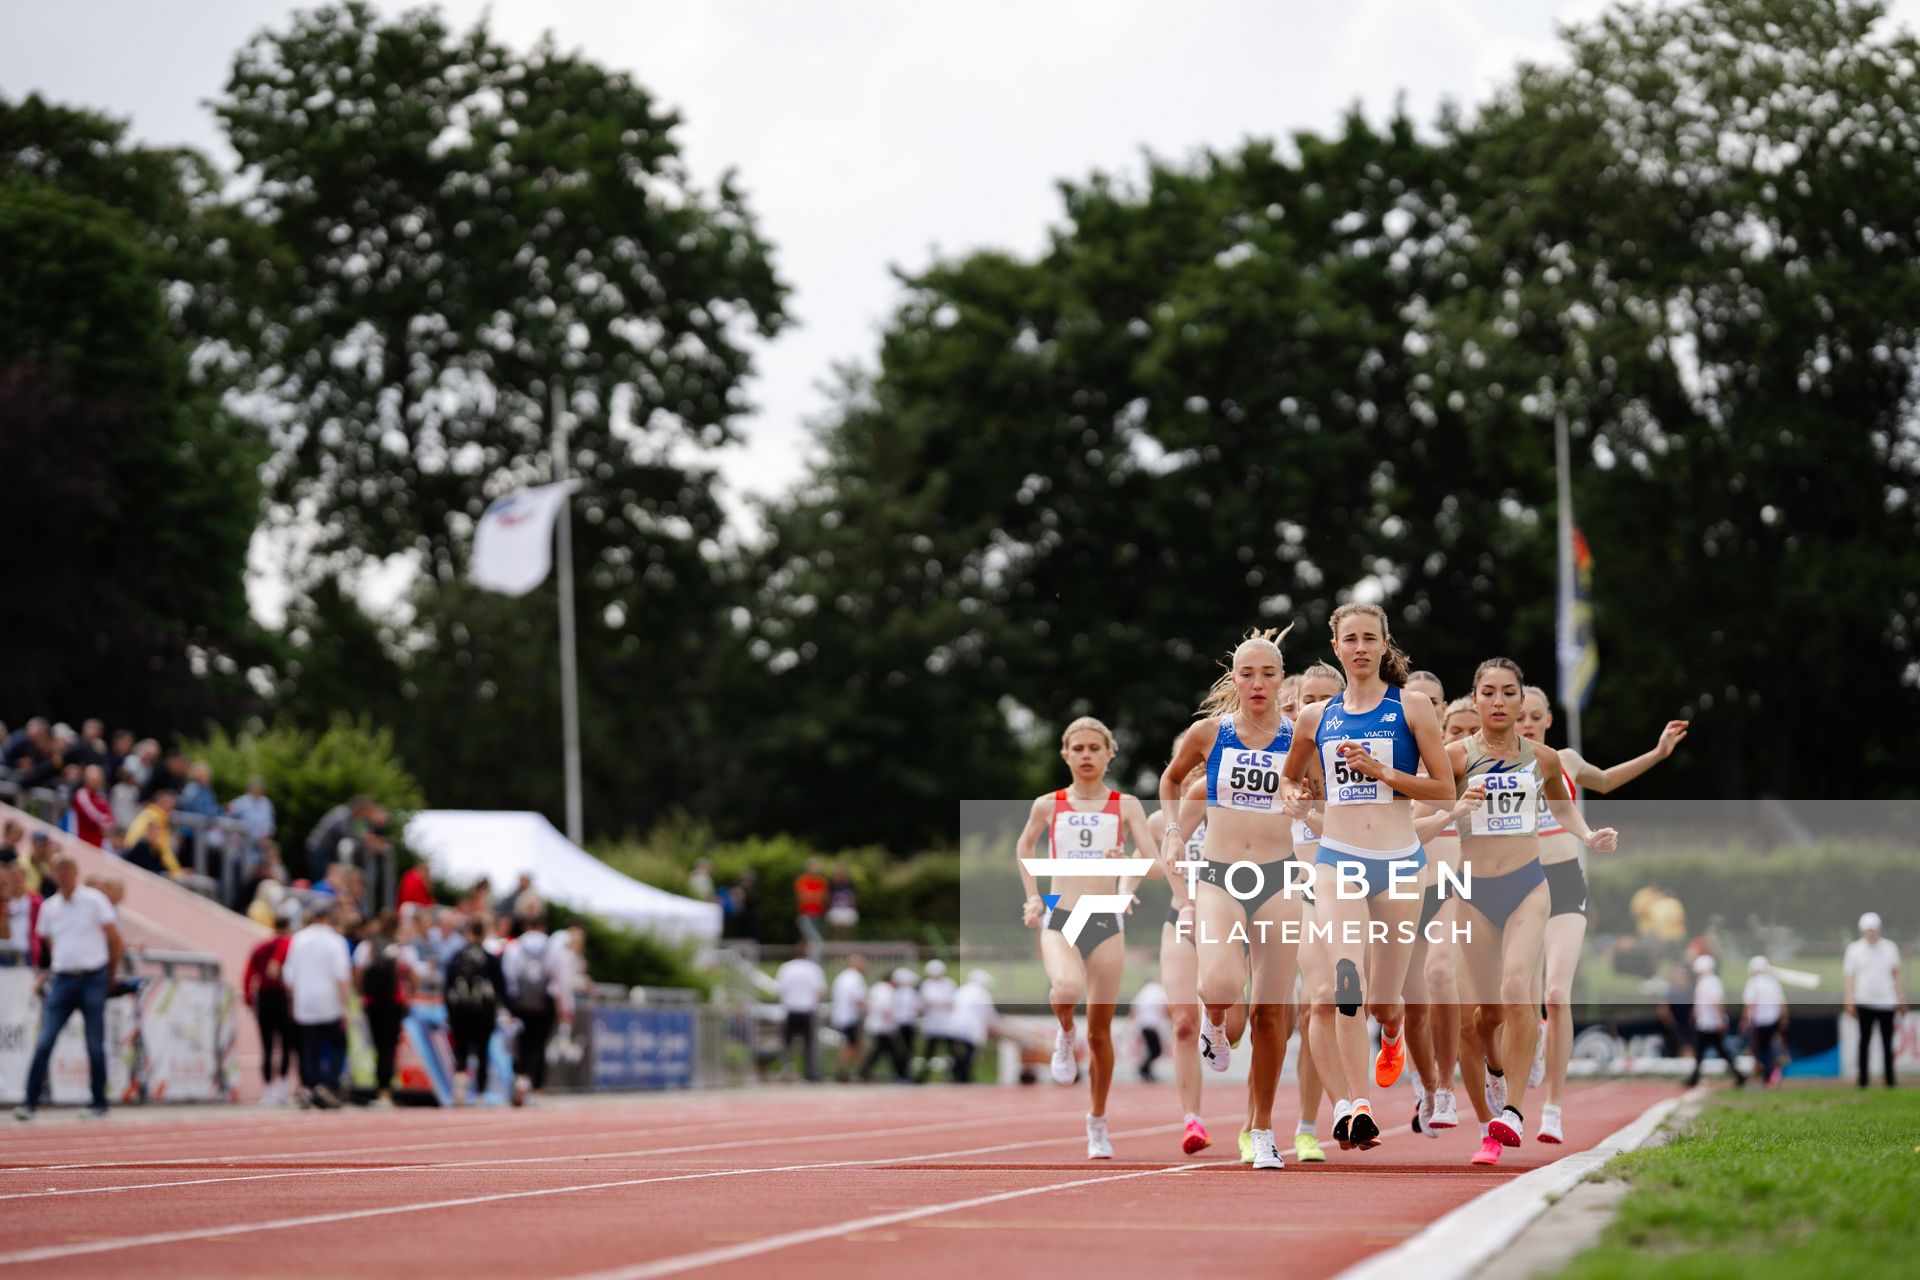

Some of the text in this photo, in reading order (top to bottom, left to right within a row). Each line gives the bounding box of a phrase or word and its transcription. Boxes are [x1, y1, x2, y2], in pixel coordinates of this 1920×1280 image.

[1363, 730, 1395, 738] VIACTIV
[1236, 752, 1273, 768] GLS
[1334, 759, 1380, 785] 58
[1230, 766, 1280, 794] 590
[1484, 776, 1518, 790] GLS
[1352, 787, 1375, 795] PLAN
[1248, 795, 1271, 805] PLAN
[1485, 791, 1526, 815] 167
[1068, 815, 1100, 827] GLS
[1079, 828, 1093, 848] 9
